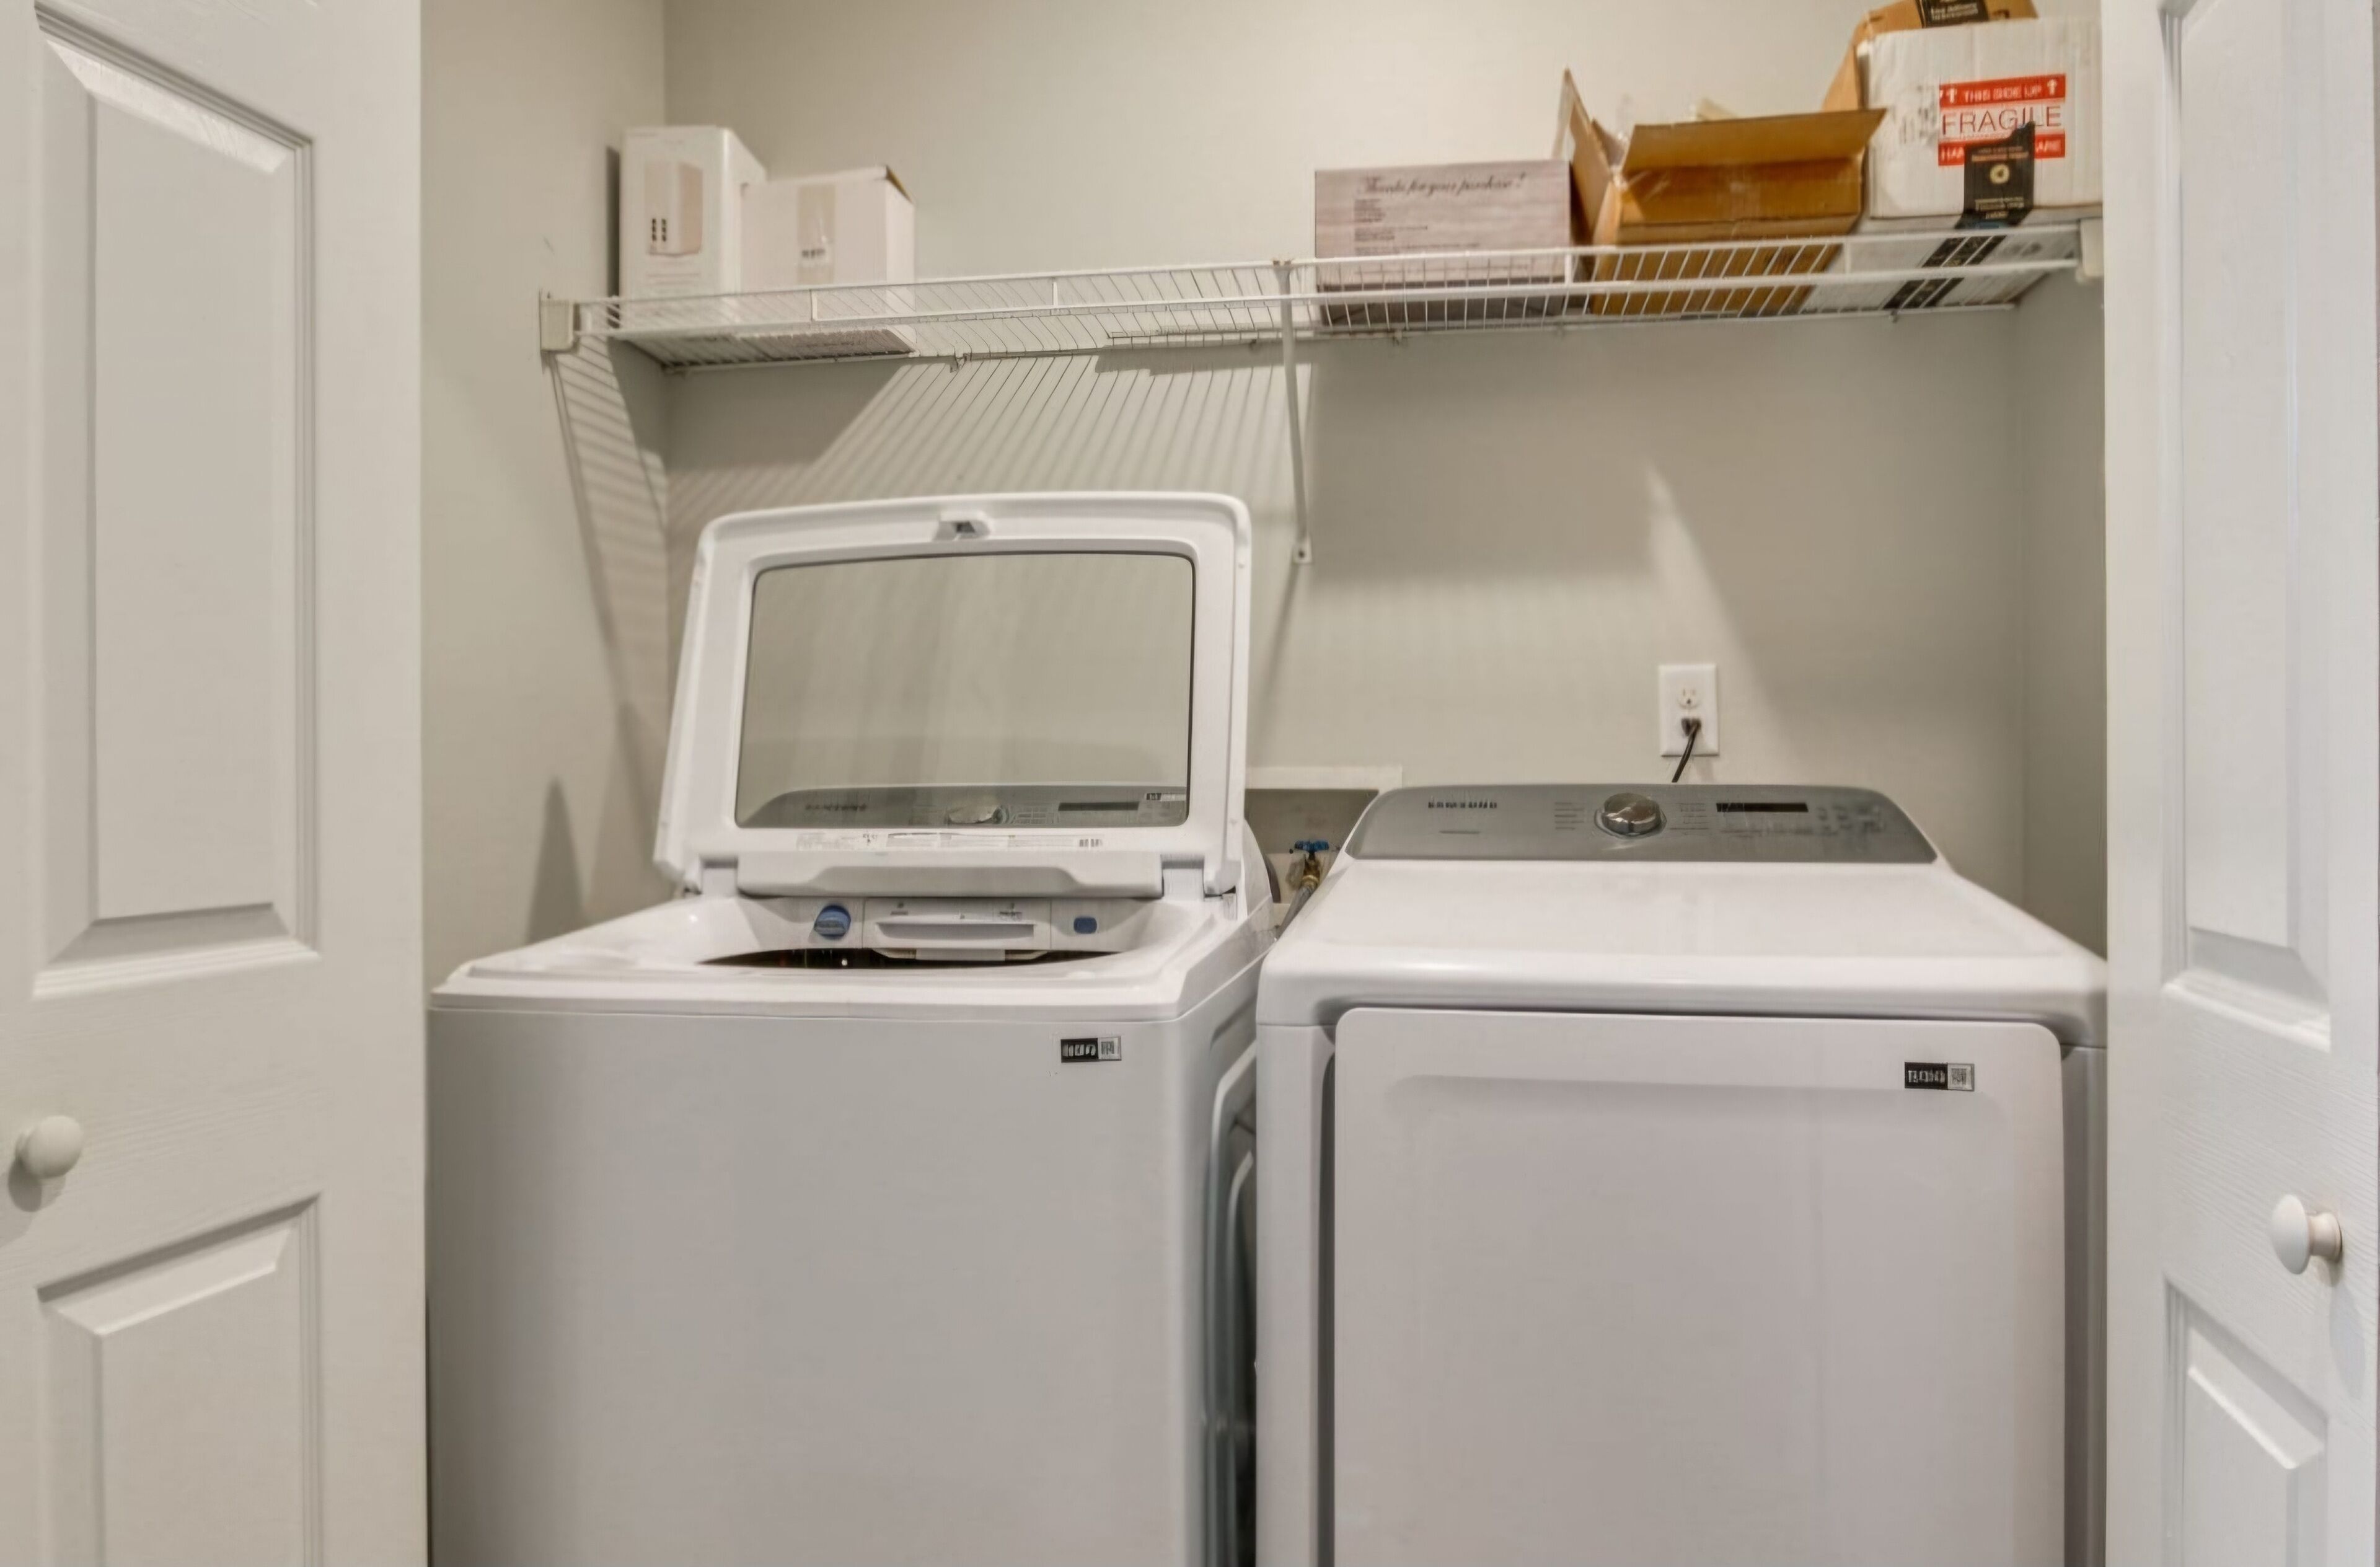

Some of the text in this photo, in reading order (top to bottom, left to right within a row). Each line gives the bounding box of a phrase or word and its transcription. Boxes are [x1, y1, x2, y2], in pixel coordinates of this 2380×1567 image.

[1965, 84, 2042, 103] THIS SIDE UP
[1942, 105, 2061, 135] FRAGILE
